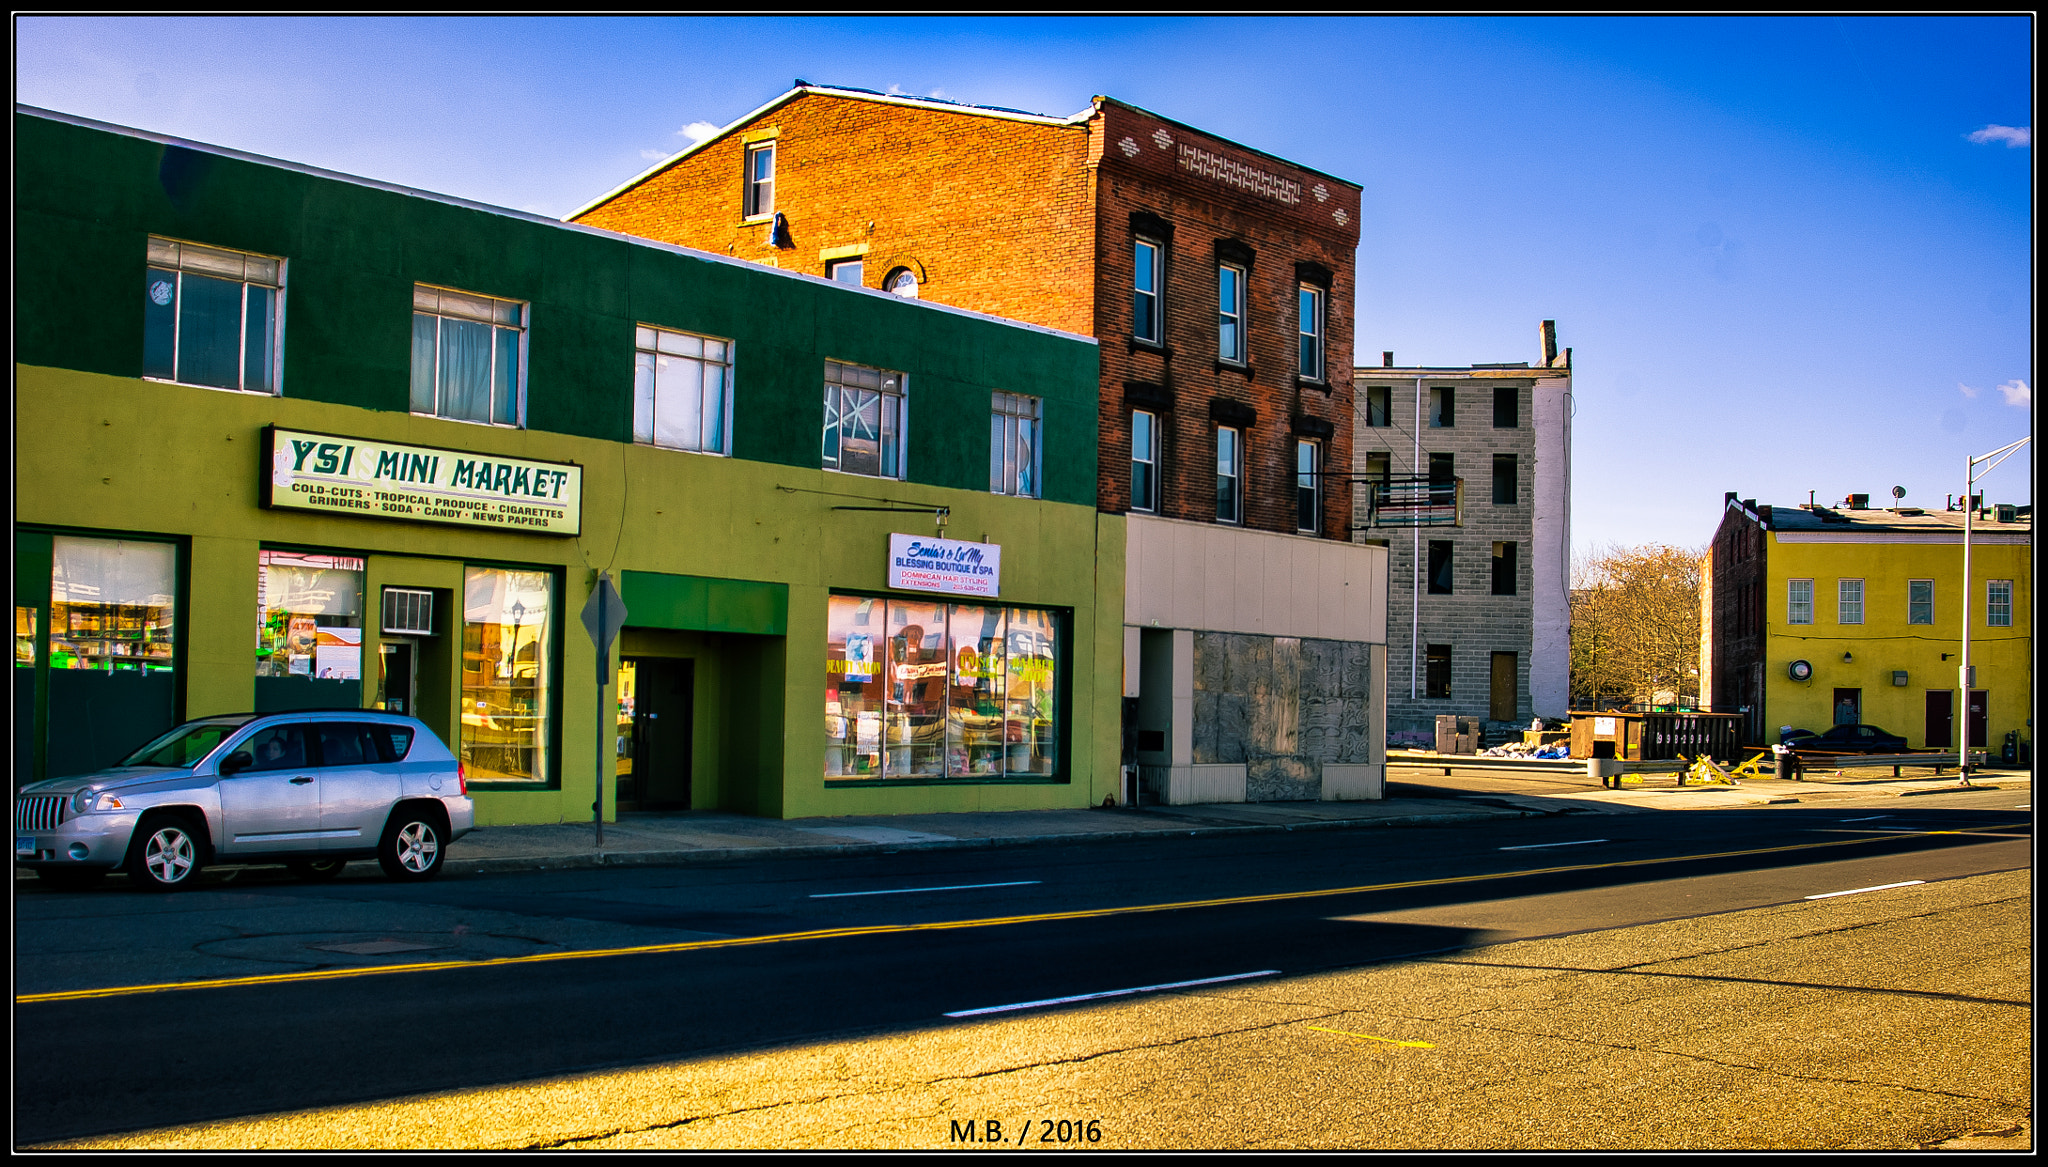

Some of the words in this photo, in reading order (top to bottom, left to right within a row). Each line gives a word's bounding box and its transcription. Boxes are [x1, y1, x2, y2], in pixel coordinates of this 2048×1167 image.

[291, 439, 355, 476] YSI
[374, 450, 439, 484] MINI
[451, 459, 568, 499] MARKET
[291, 483, 363, 498] COLD-CUTS
[374, 491, 431, 505] TROPICAL
[435, 498, 488, 511] PRODUCE
[498, 504, 564, 519] CIGARETTES
[308, 495, 371, 509] GRINDERS
[381, 502, 413, 514] SODA
[424, 507, 462, 519] CANDY
[472, 511, 504, 523] NEWS
[507, 515, 549, 527] PAPERS
[896, 557, 933, 569] BLESSING
[936, 562, 970, 573] BOUTIQUE
[979, 566, 993, 575] SPA
[901, 579, 940, 588] EXTENSIONS
[902, 571, 940, 580] DOMINICAN
[943, 575, 959, 583] HAIR
[960, 577, 988, 585] STYLING
[292, 621, 315, 632] ATM
[826, 659, 854, 674] BEAUTY
[856, 661, 881, 675] SALON
[1018, 671, 1048, 683] SHOP
